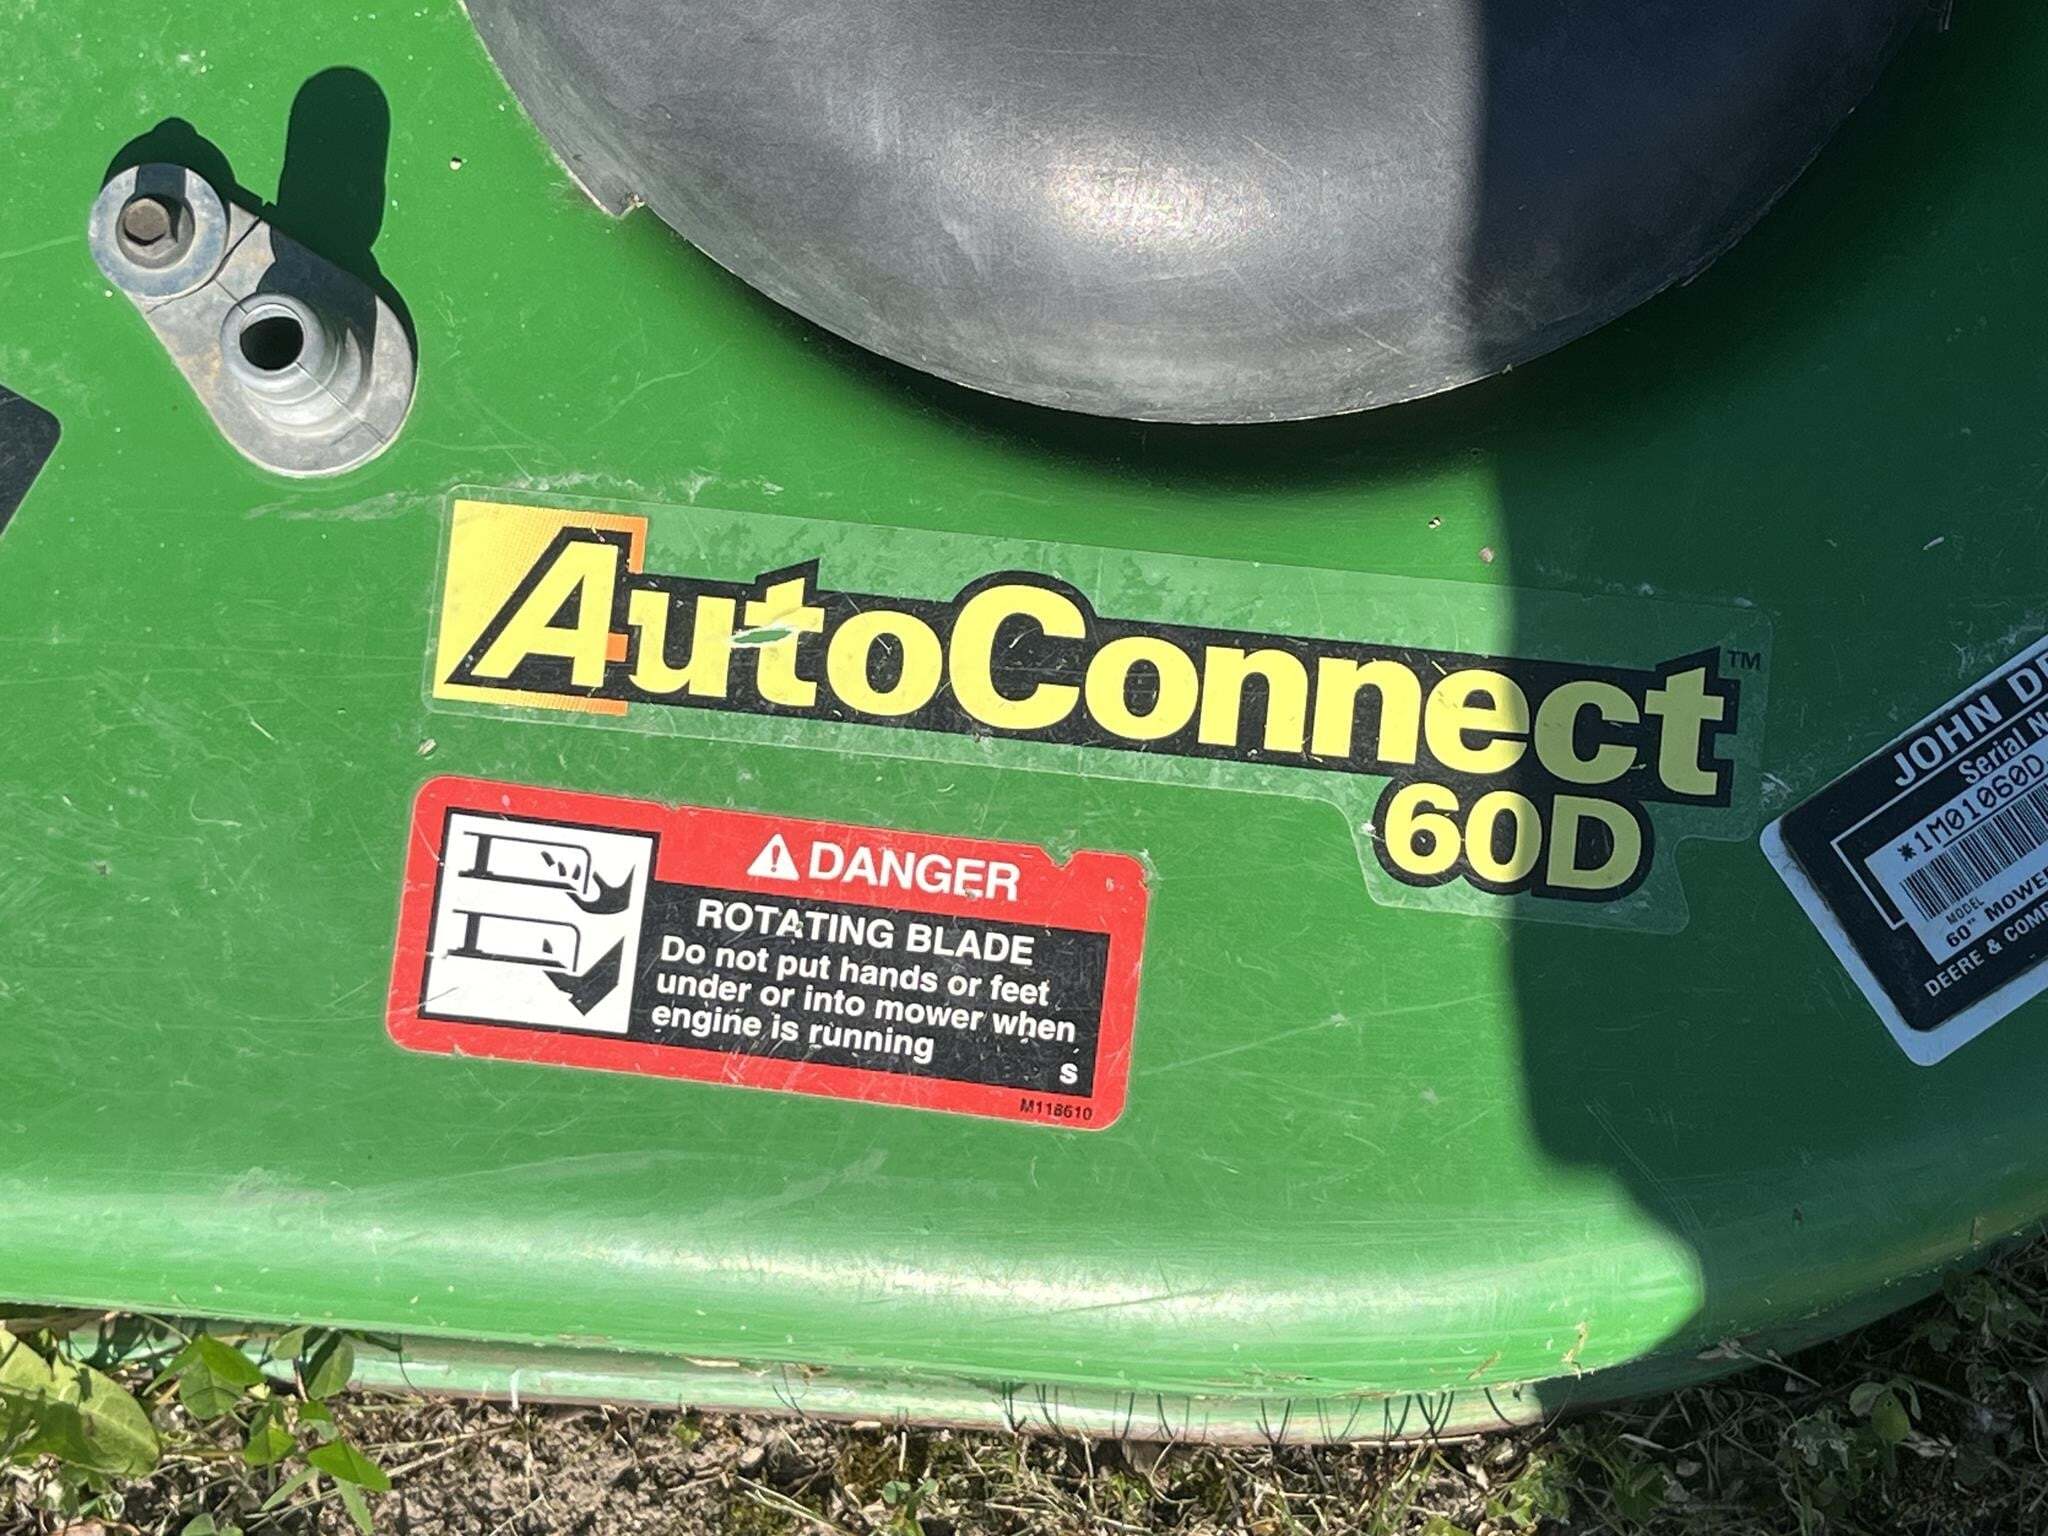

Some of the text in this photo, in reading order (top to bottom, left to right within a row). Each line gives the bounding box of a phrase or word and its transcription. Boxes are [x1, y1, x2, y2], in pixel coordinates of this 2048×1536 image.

[469, 540, 1726, 797] AutoConnect
[1894, 694, 2002, 786] JOHN
[1958, 711, 2048, 784] Serial N
[1383, 782, 1643, 890] 60D
[1898, 754, 2048, 862] 1M01060D
[809, 841, 1021, 901] DANGER
[1984, 866, 2048, 922] MOWE
[696, 898, 1035, 966] ROTATING BLADE
[1945, 896, 1985, 925] MODEL
[661, 935, 1050, 1007] Do not put hands or feet
[1924, 949, 1985, 997] DEERE
[1986, 938, 2003, 955] &
[651, 1004, 934, 1065] engine is running
[656, 972, 1076, 1043] under or into mower when
[1020, 1098, 1093, 1121] M118610
